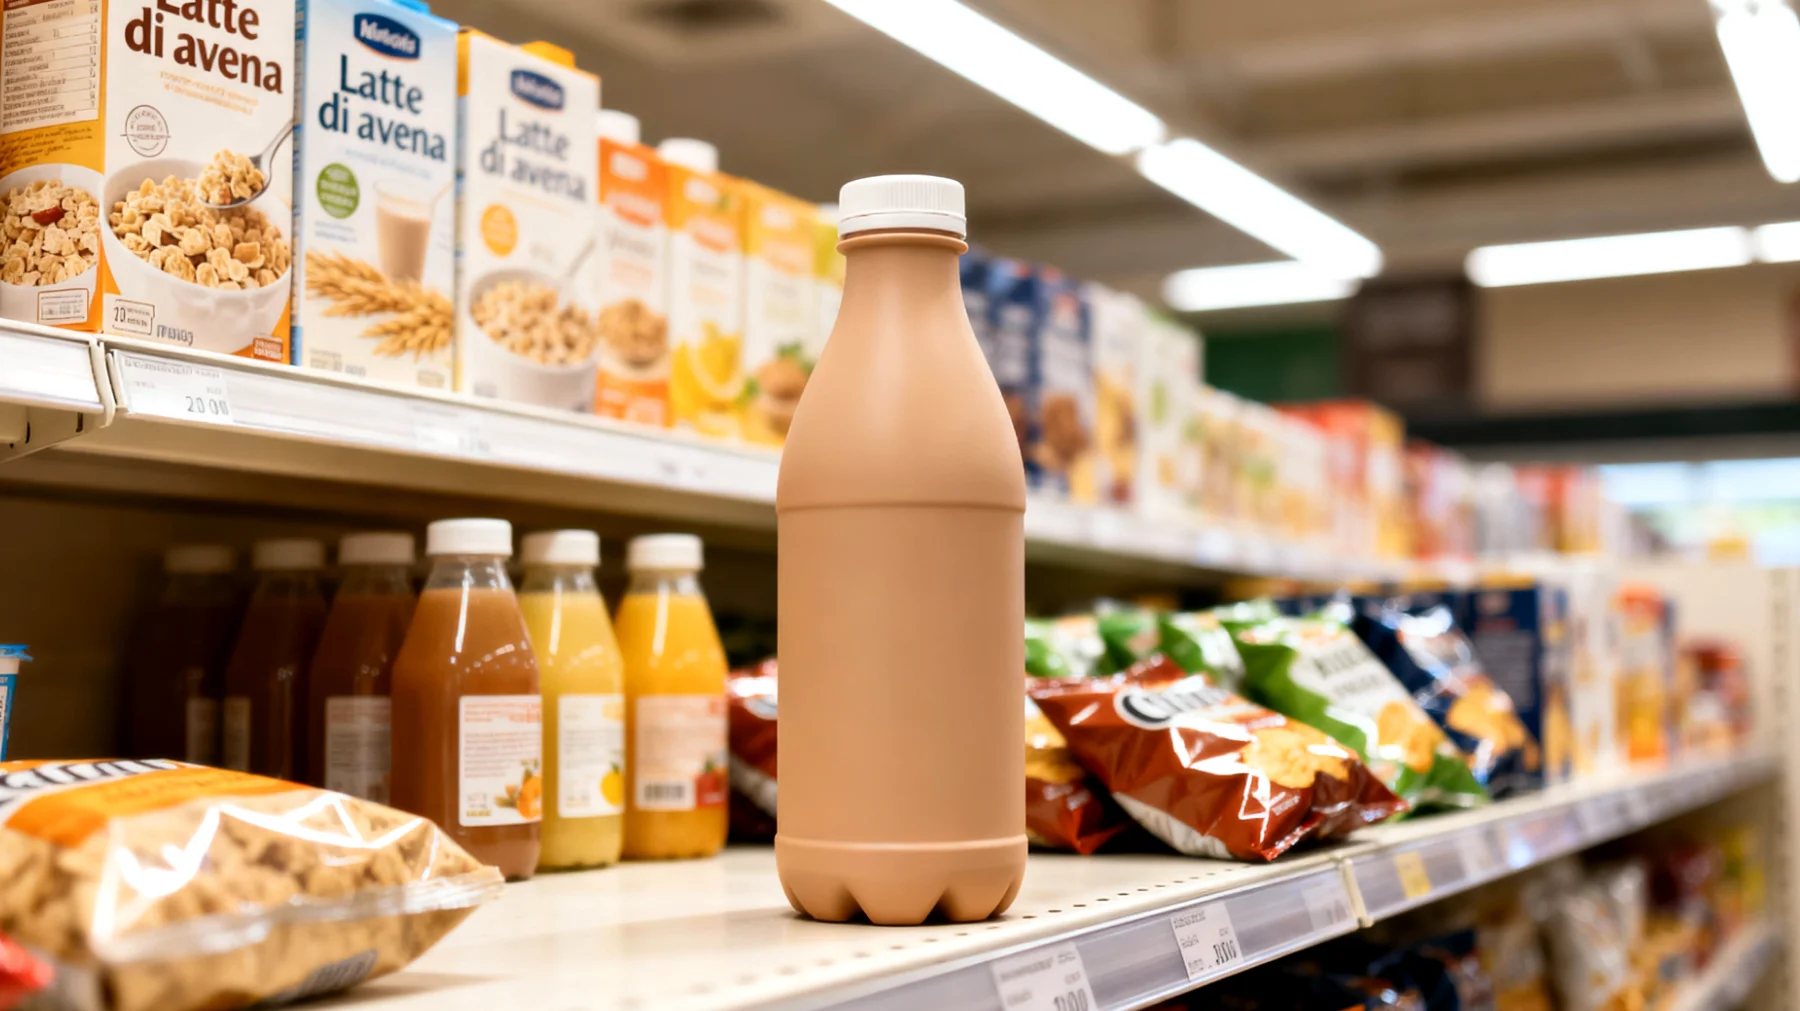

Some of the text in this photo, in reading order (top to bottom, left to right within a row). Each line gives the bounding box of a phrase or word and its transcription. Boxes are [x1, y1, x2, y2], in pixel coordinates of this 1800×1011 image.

[124, 6, 164, 58] di
[173, 33, 283, 94] avena
[341, 54, 423, 115] Latte
[318, 92, 446, 162] di avena
[499, 107, 569, 160] Latte
[480, 140, 504, 176] di
[511, 157, 587, 201] avena
